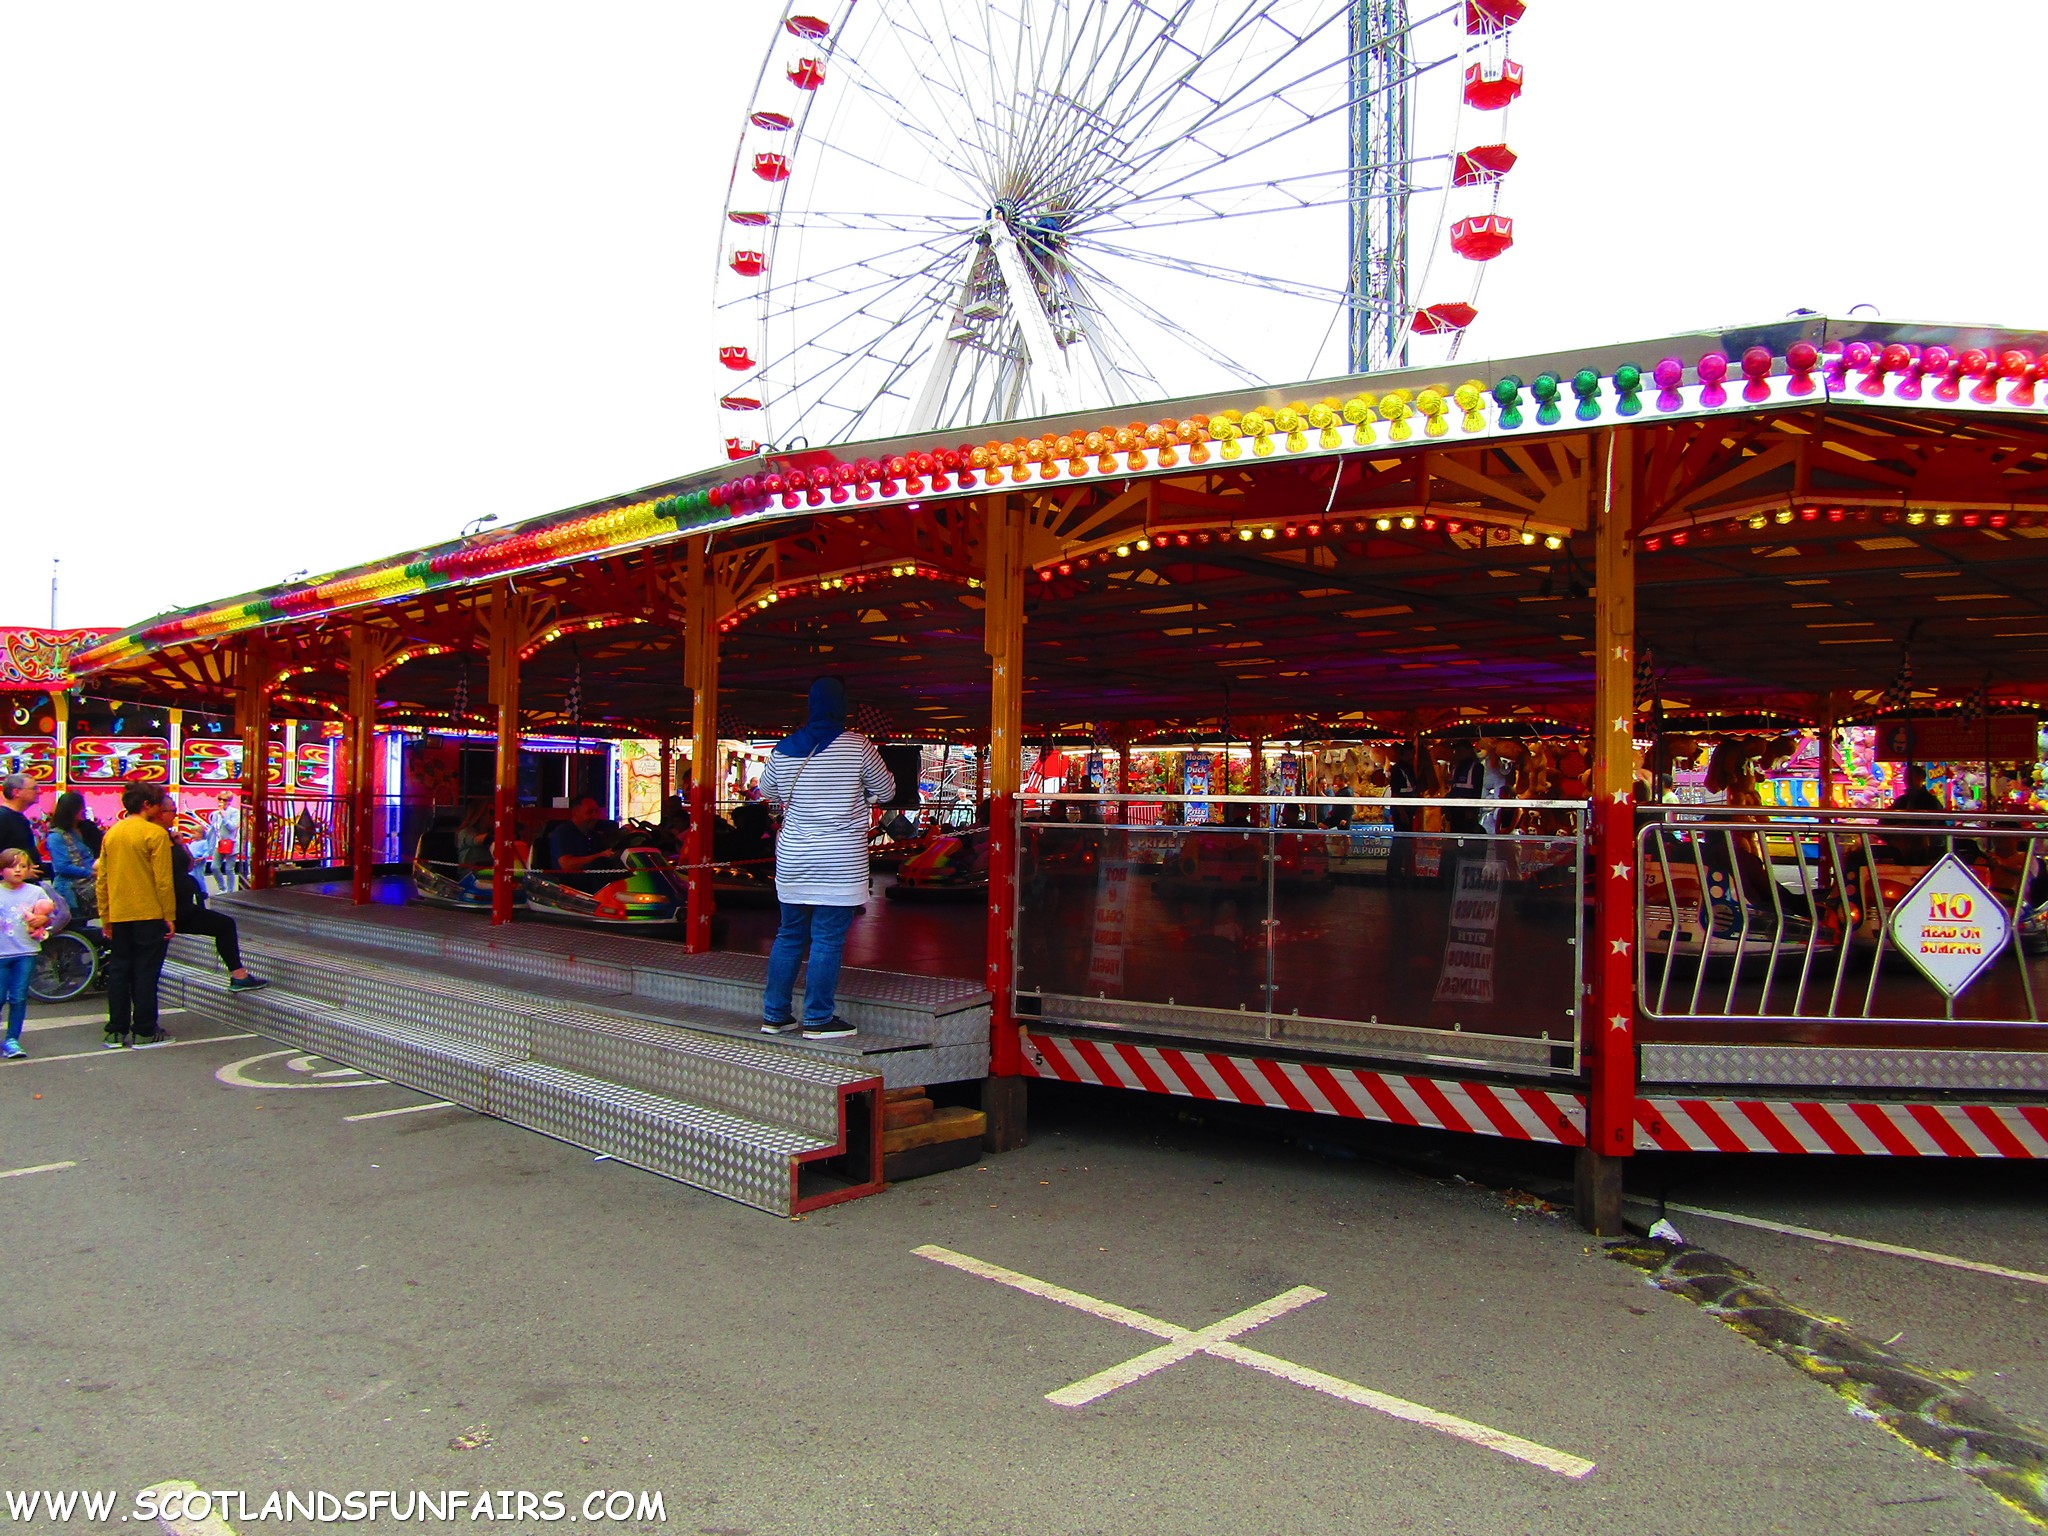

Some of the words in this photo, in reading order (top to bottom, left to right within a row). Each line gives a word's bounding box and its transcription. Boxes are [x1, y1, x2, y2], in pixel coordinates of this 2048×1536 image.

[1186, 752, 1207, 761] Hook
[1187, 807, 1206, 815] Prize
[1137, 838, 1176, 848] PRIZE
[1645, 873, 1656, 884] 13
[1929, 892, 1973, 919] NO
[1920, 925, 1957, 938] HEAD
[1960, 926, 1981, 939] ON
[1920, 941, 1982, 955] BUMPING
[1035, 1053, 1043, 1065] 5
[1651, 1121, 1662, 1135] 6
[1614, 1127, 1625, 1143] 6
